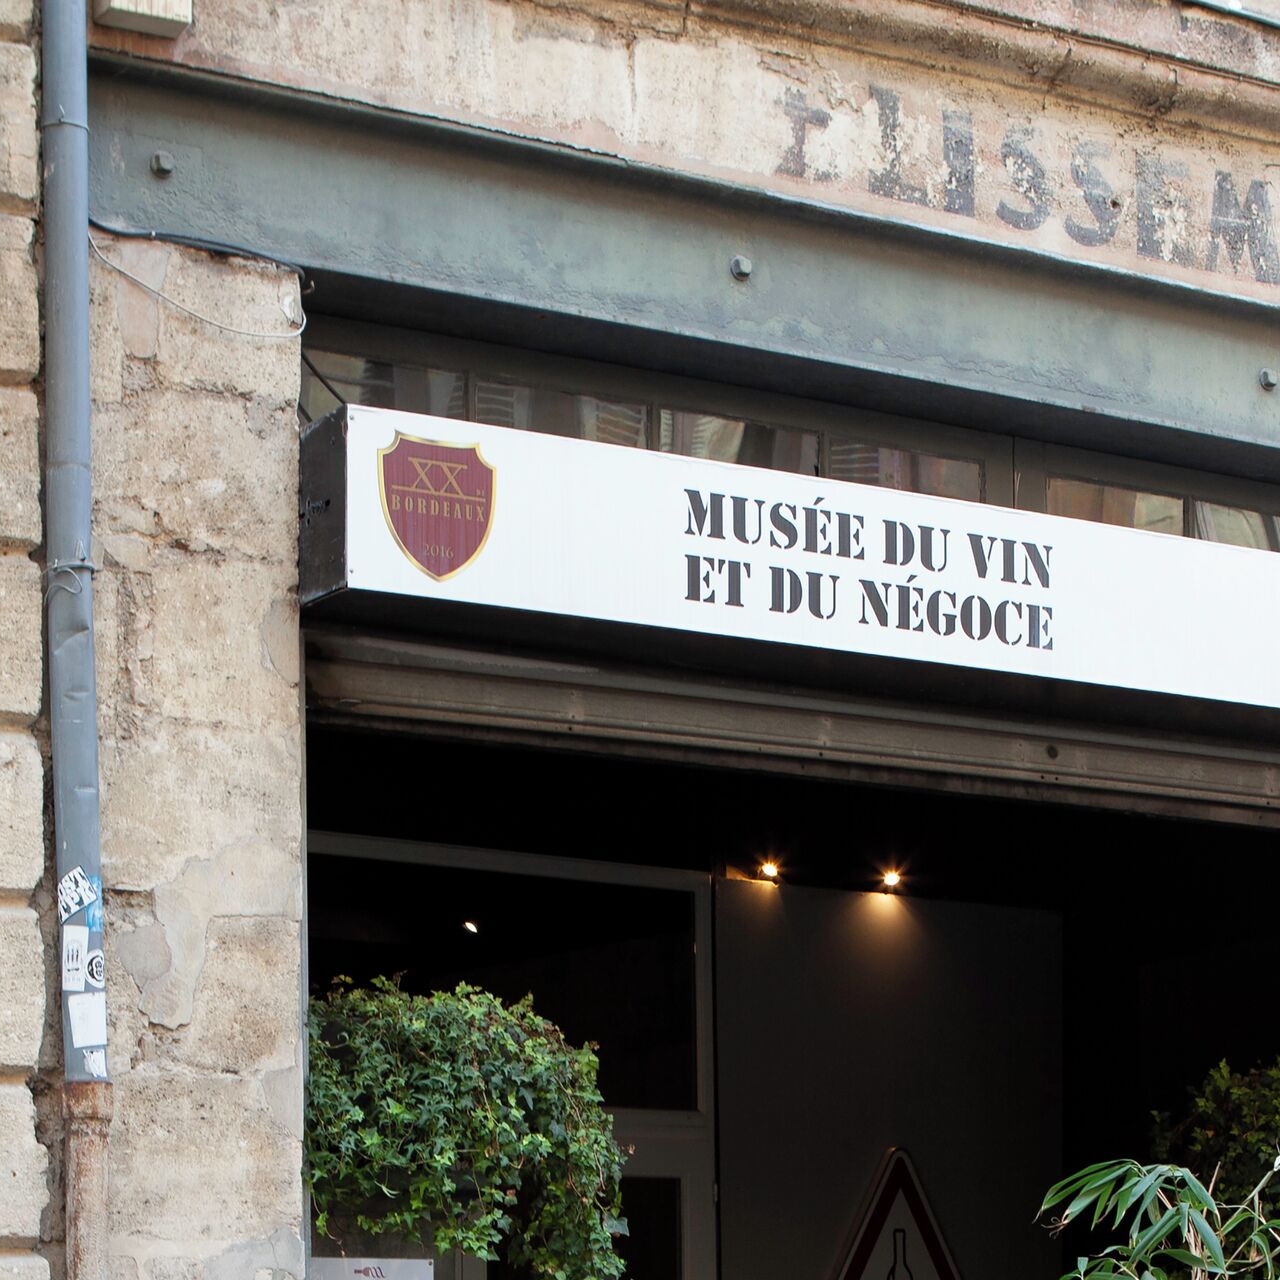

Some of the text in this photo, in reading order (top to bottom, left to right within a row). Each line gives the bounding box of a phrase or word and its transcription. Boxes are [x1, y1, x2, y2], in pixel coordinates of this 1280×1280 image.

[391, 494, 485, 522] BORDEAUX
[684, 488, 1053, 589] MUSÉE DU VIN
[423, 543, 456, 560] 2016
[684, 554, 1053, 651] ET DU NÉGOCE
